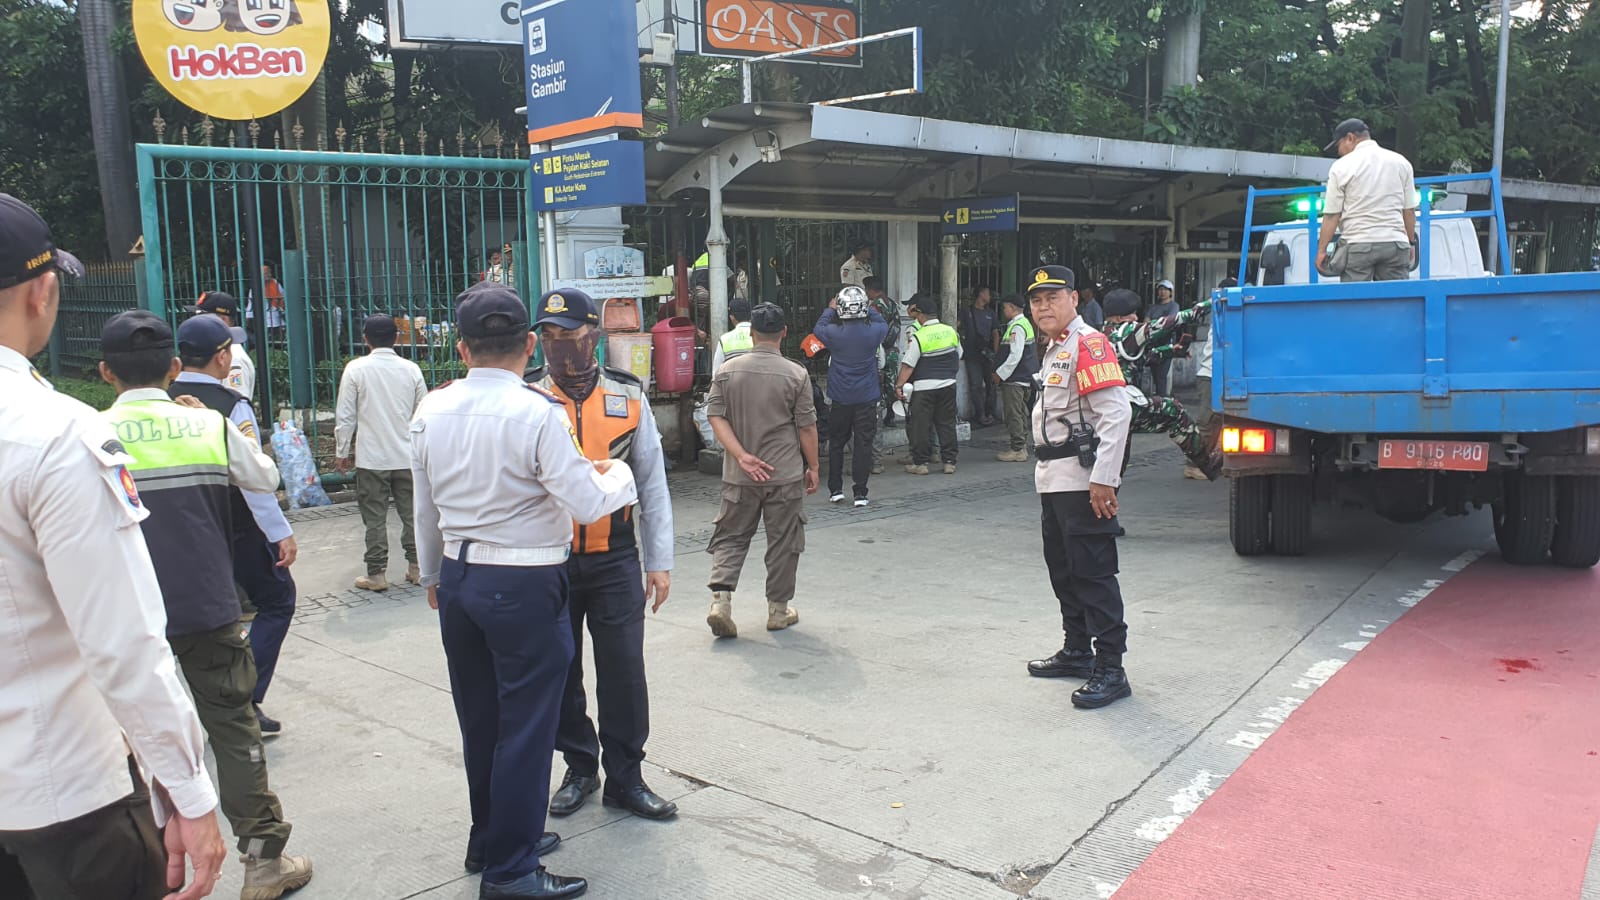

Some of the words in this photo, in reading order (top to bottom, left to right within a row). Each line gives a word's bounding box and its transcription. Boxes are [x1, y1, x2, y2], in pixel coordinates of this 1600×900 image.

[711, 4, 850, 53] OASIS
[169, 44, 304, 79] HokBen
[530, 58, 566, 80] Stasiun
[531, 75, 567, 99] Gambir
[575, 151, 590, 160] Masuk
[591, 160, 609, 168] Selatan
[1051, 362, 1070, 370] POLRI
[114, 418, 162, 443] OL
[165, 417, 206, 439] PP
[1383, 442, 1392, 458] B
[1406, 443, 1445, 460] 9116
